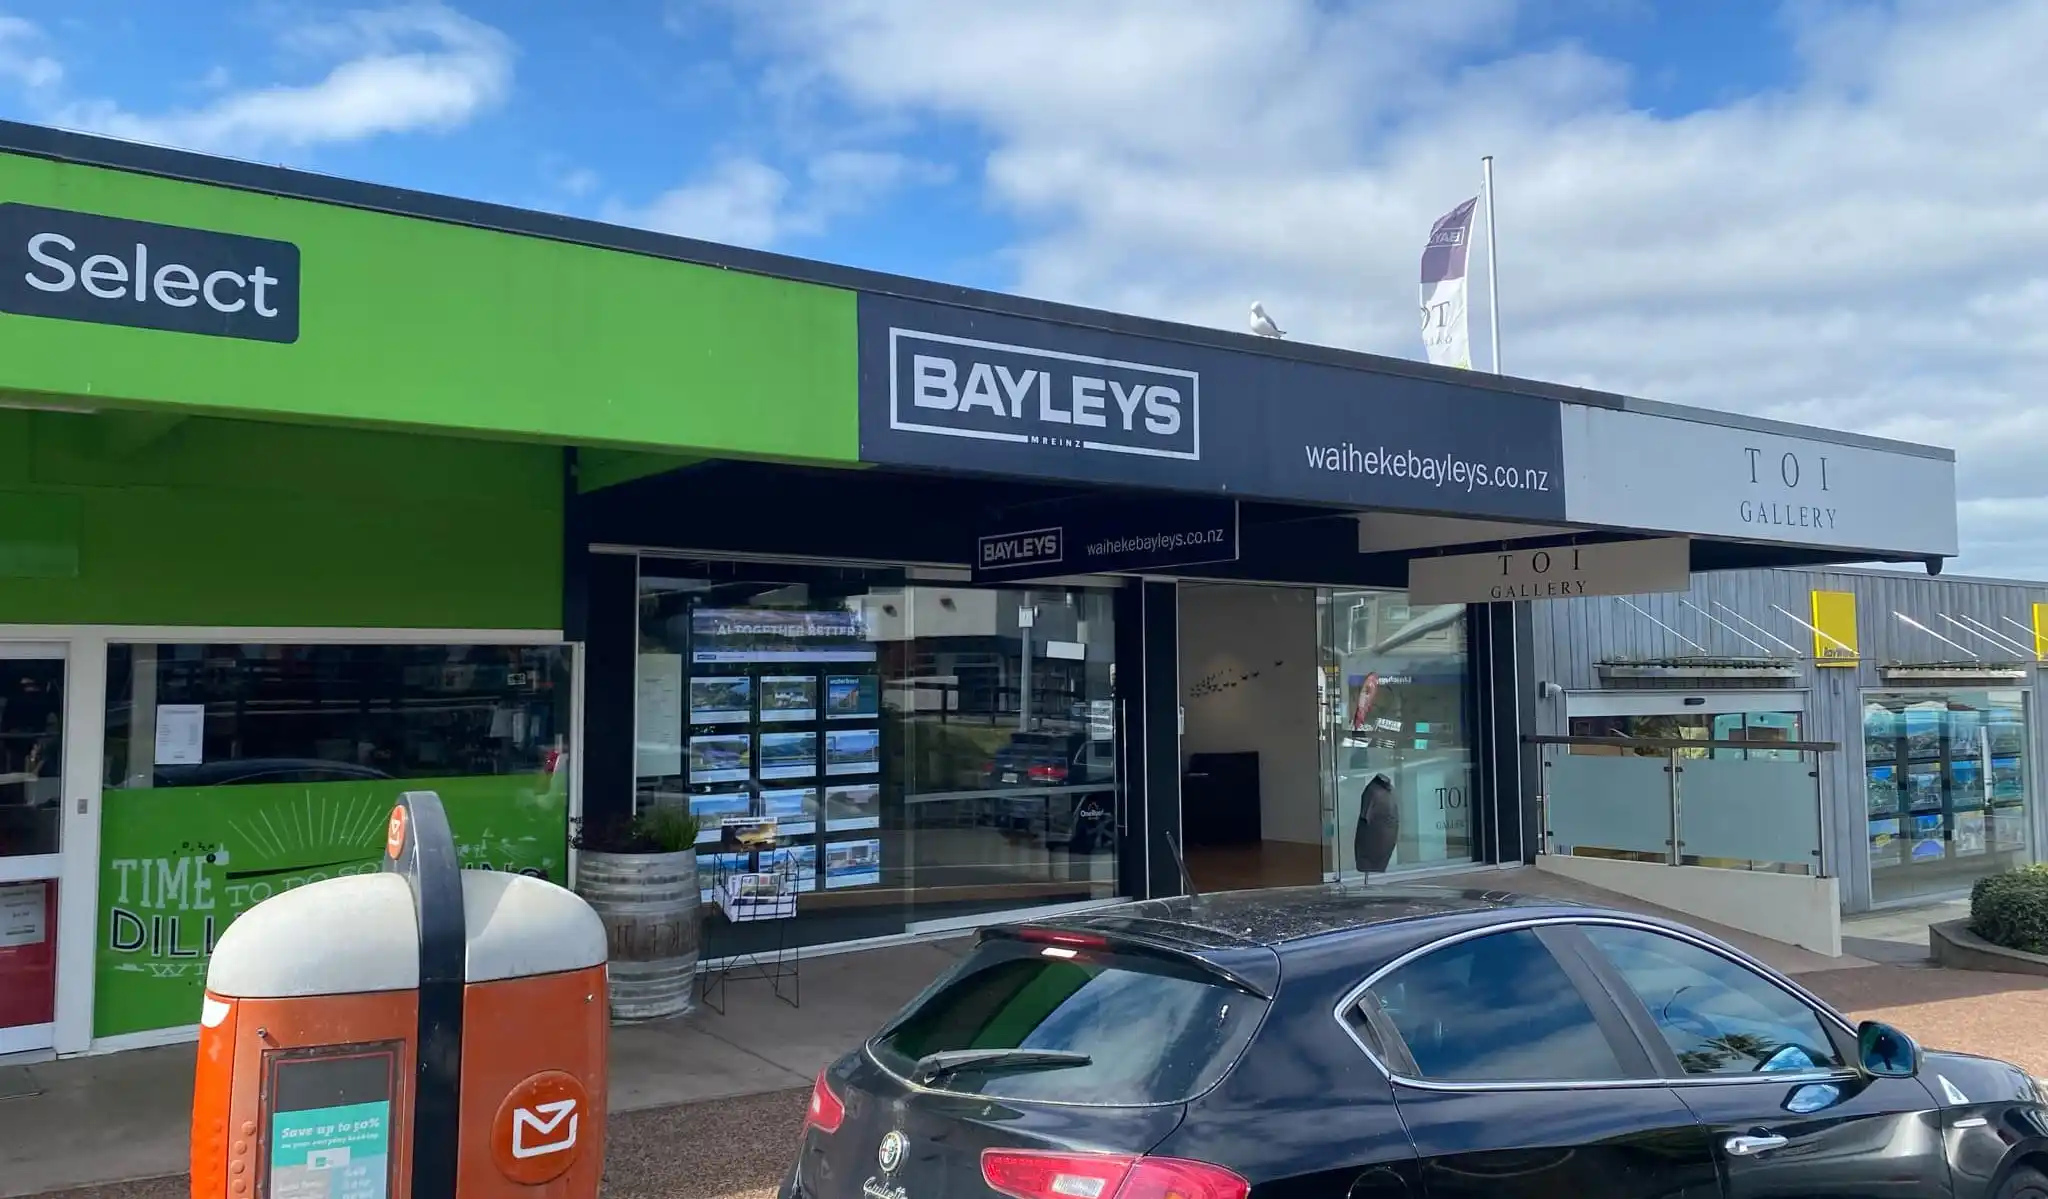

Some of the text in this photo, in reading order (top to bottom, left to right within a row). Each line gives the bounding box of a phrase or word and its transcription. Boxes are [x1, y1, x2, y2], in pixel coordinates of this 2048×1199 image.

[25, 233, 278, 317] Select
[913, 354, 1181, 435] BAYLEYS
[1031, 435, 1081, 448] MREINZ
[1305, 442, 1549, 492] waihekebayleys.co.nz
[1740, 500, 1836, 529] GALLERY
[984, 534, 1057, 561] BAYLEYS
[1087, 529, 1224, 556] waihekebayleys.co.nz
[1491, 580, 1587, 599] GALLERY
[112, 855, 216, 910] TIME
[225, 881, 272, 907] TO
[110, 906, 214, 958] DILL
[281, 1117, 380, 1139] Save up to 50%
